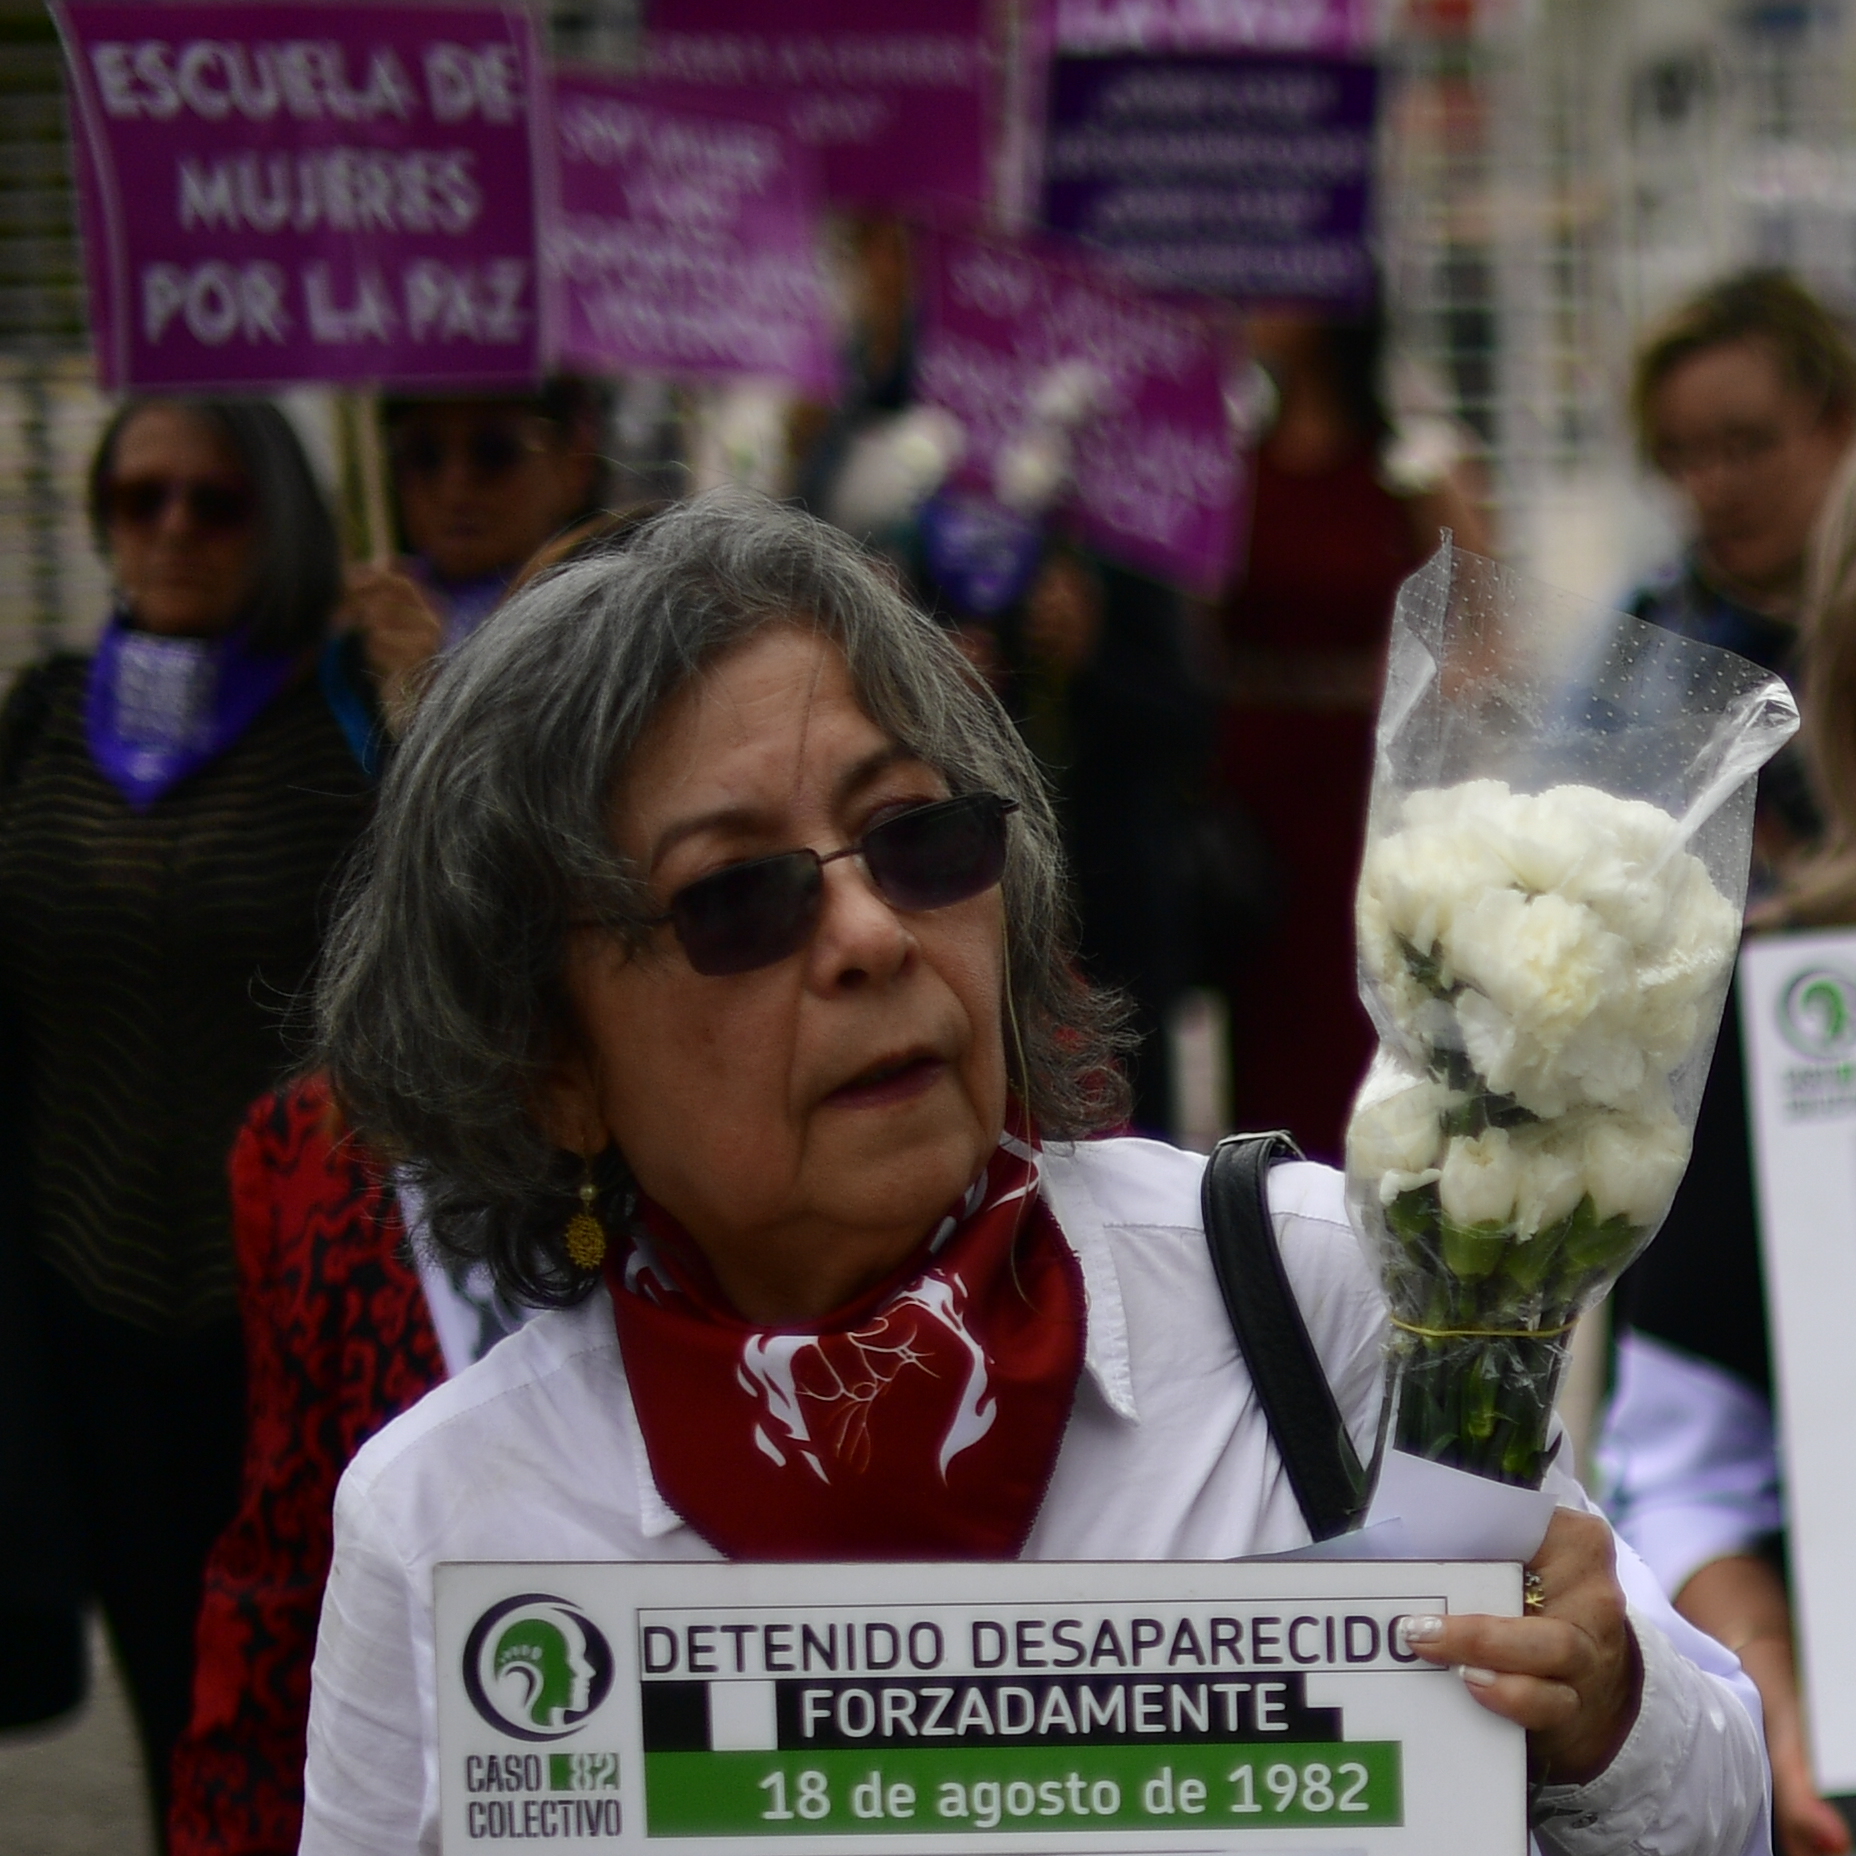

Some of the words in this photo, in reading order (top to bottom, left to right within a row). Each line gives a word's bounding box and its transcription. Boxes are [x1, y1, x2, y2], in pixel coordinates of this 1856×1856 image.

[92, 40, 410, 122] ESCUELA
[424, 42, 523, 122] DE
[178, 148, 481, 233] MUJERES
[142, 259, 285, 345] POR
[304, 260, 394, 344] LA
[404, 257, 525, 344] PAZ
[642, 1622, 943, 1674] DETENIDO
[801, 1683, 1289, 1739] FORZADAMENTE
[465, 1754, 543, 1792] CASO
[568, 1752, 620, 1790] 82
[758, 1770, 830, 1820] 18
[853, 1768, 916, 1818] de
[934, 1773, 1120, 1828] agosto
[1144, 1766, 1207, 1813] de
[1228, 1762, 1369, 1813] 1982
[467, 1800, 623, 1839] COLECTIVO
